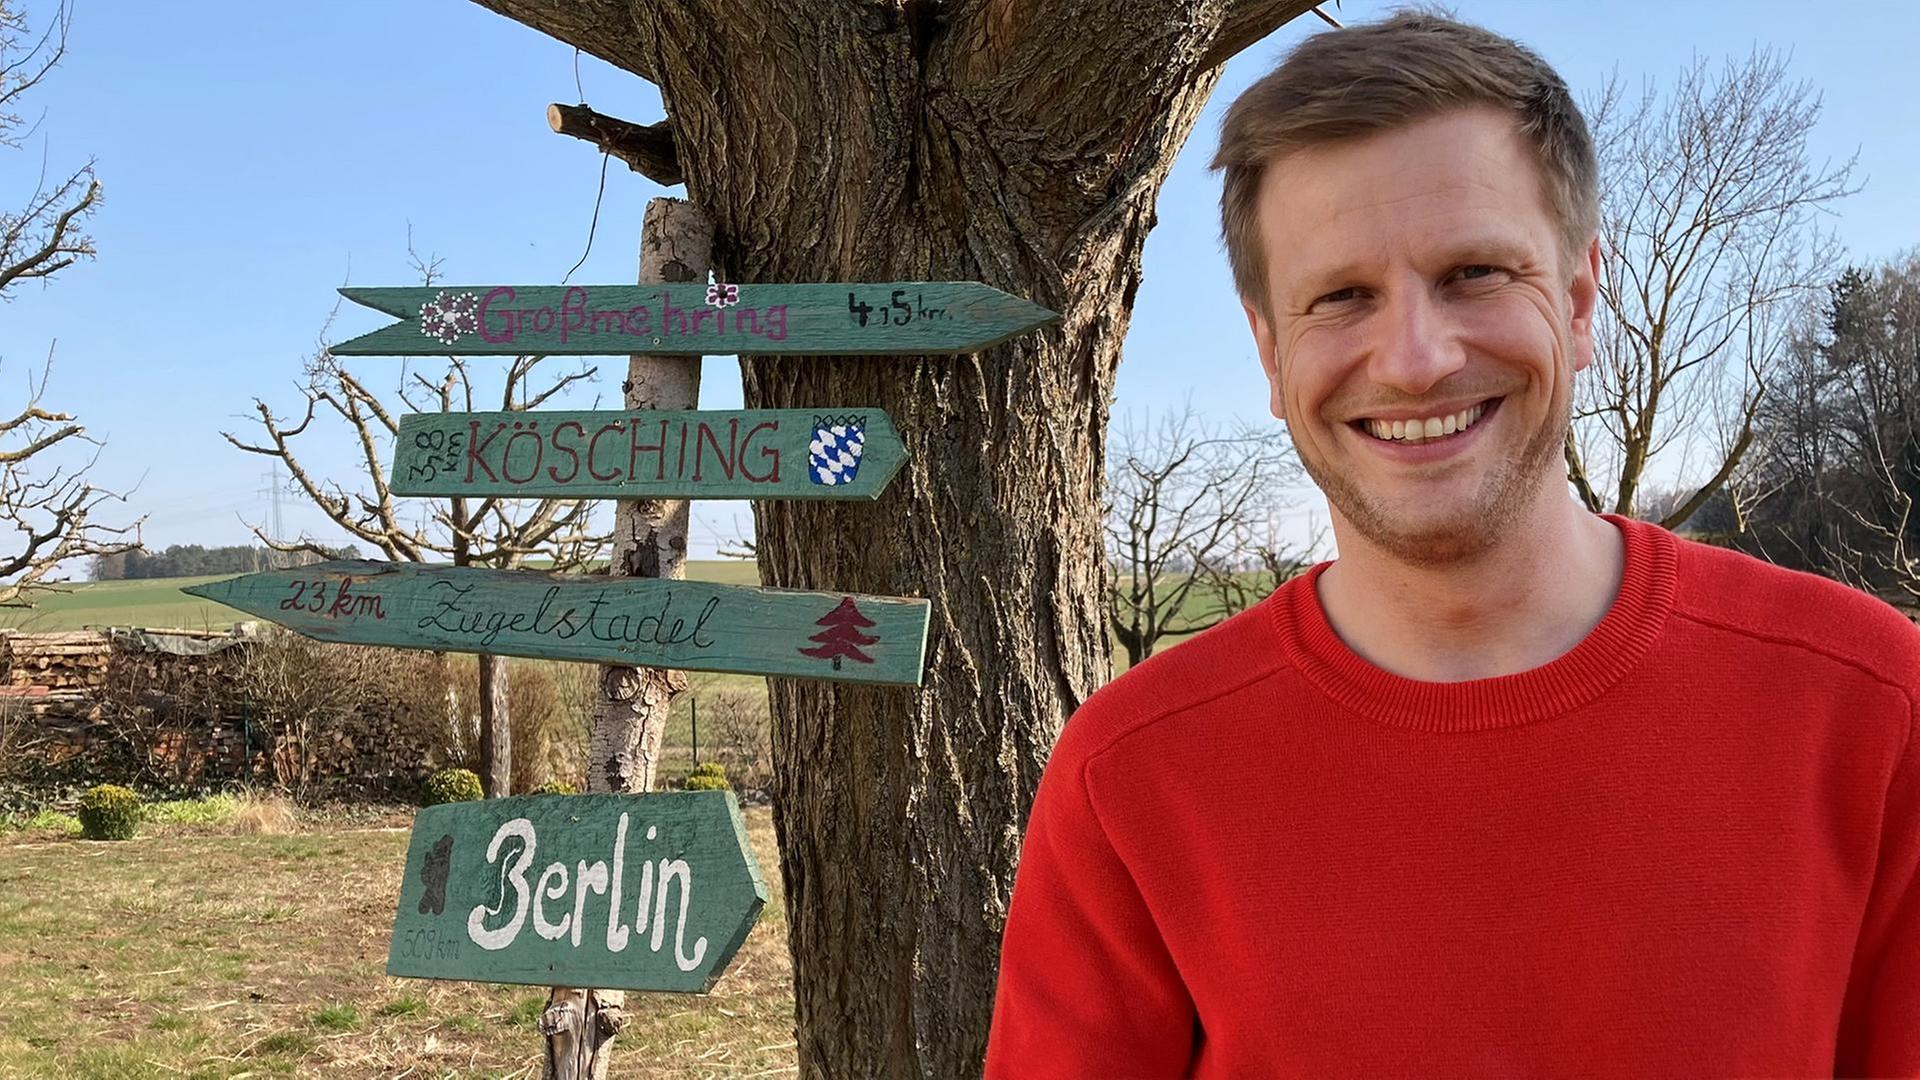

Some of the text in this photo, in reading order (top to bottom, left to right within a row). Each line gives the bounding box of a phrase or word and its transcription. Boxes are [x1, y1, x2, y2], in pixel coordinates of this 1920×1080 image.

[477, 286, 788, 344] Großmehring
[442, 432, 464, 472] km
[463, 418, 782, 484] KÖSCHING
[467, 812, 708, 971] Berlin
